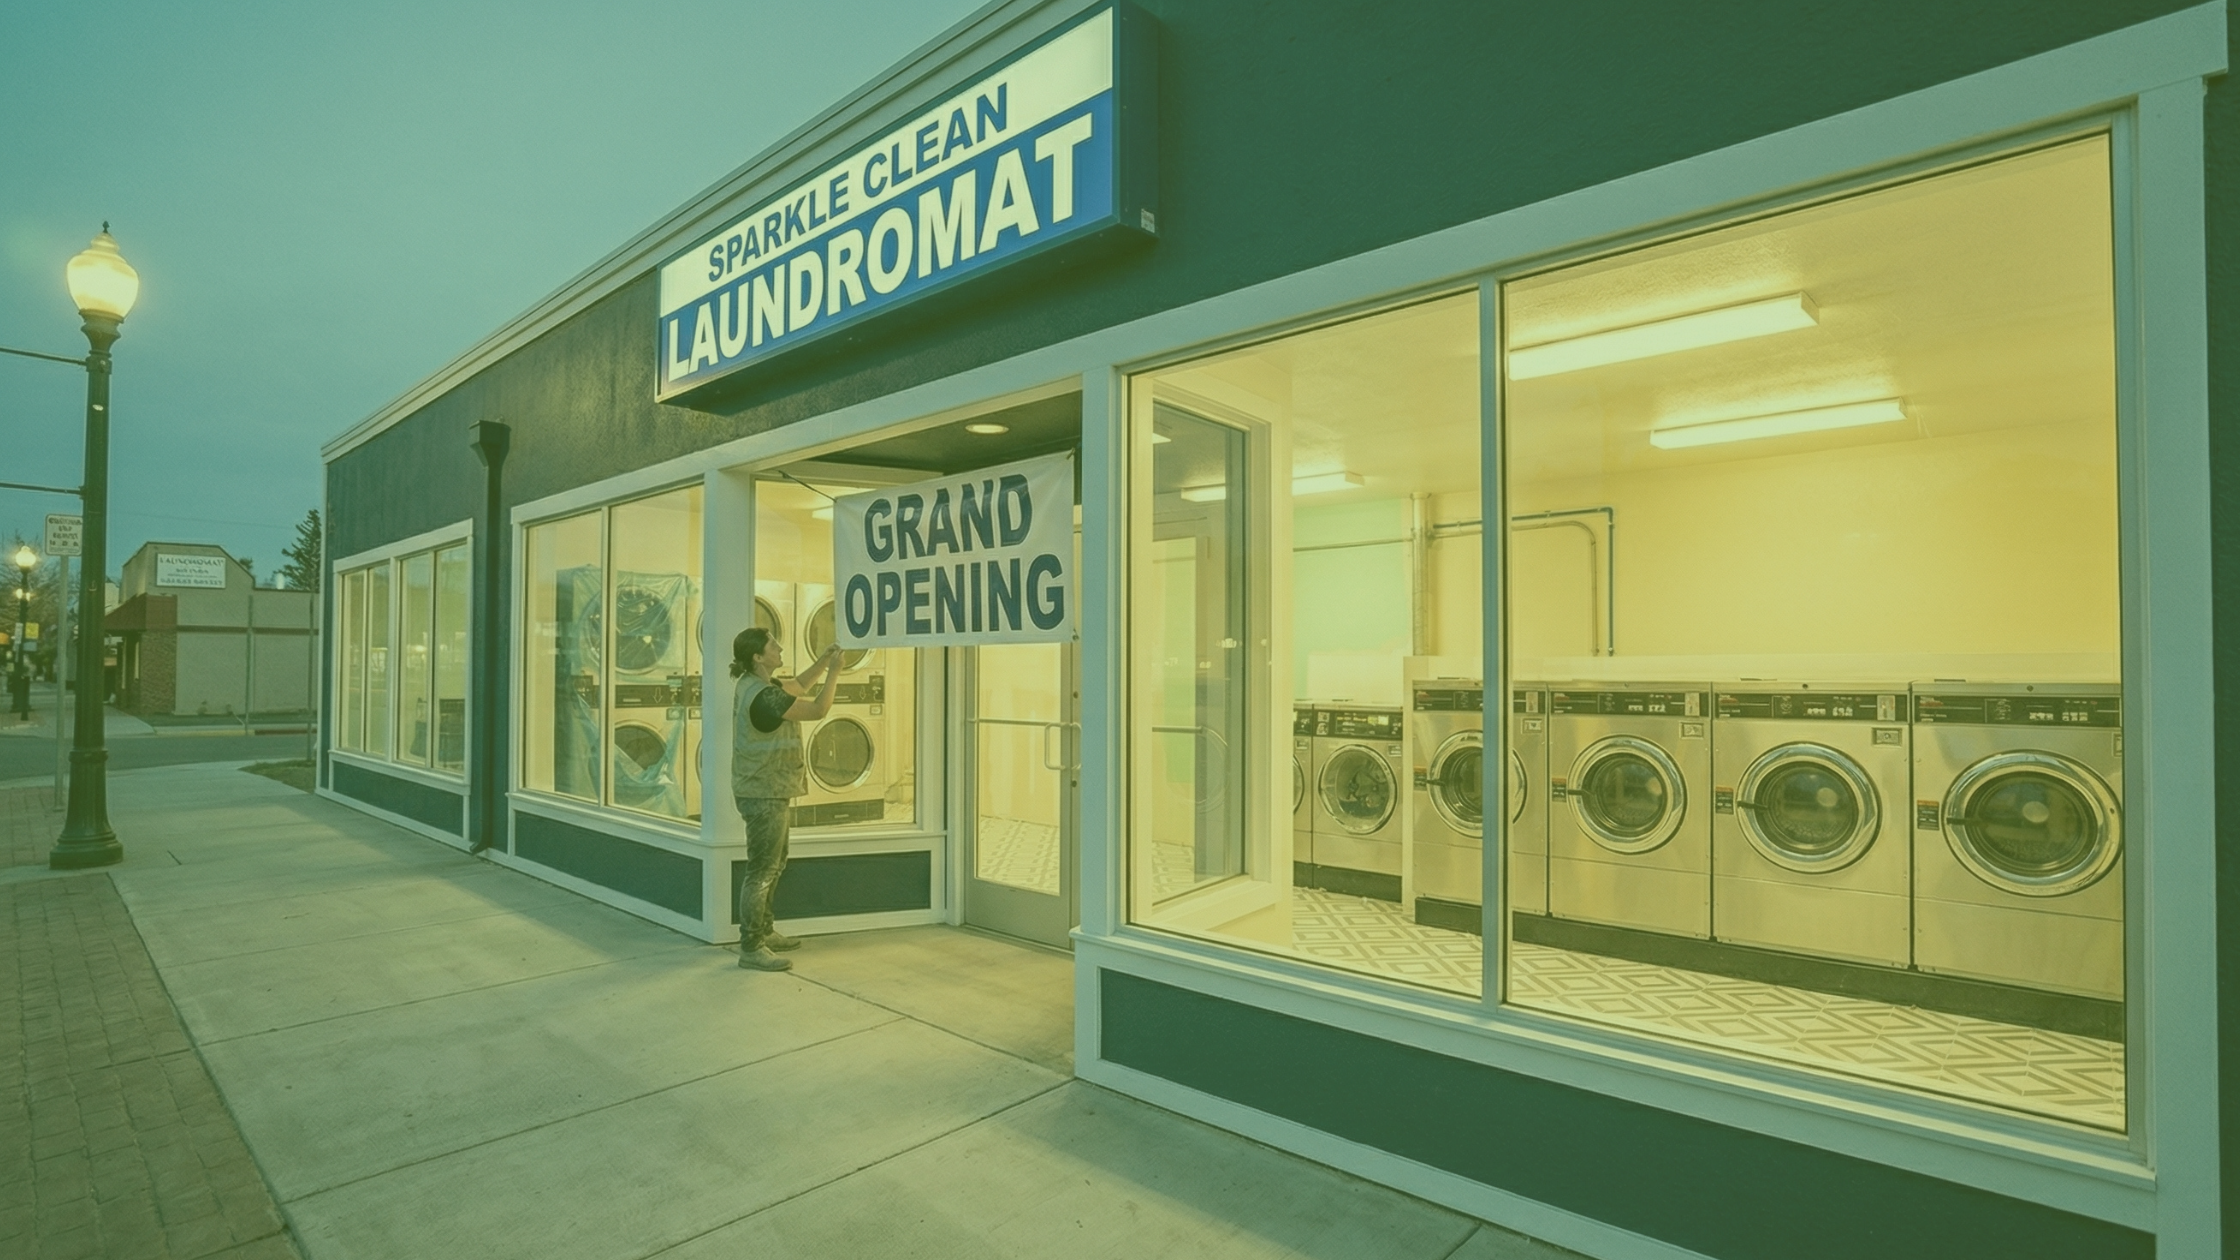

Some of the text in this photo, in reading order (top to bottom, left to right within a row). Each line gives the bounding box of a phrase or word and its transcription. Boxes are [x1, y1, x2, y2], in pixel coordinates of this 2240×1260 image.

[667, 112, 1094, 382] LAUNDROMAT
[708, 82, 1008, 283] SPARKLE CLEAN
[864, 473, 1033, 563] GRAND
[845, 553, 1065, 639] OPENING
